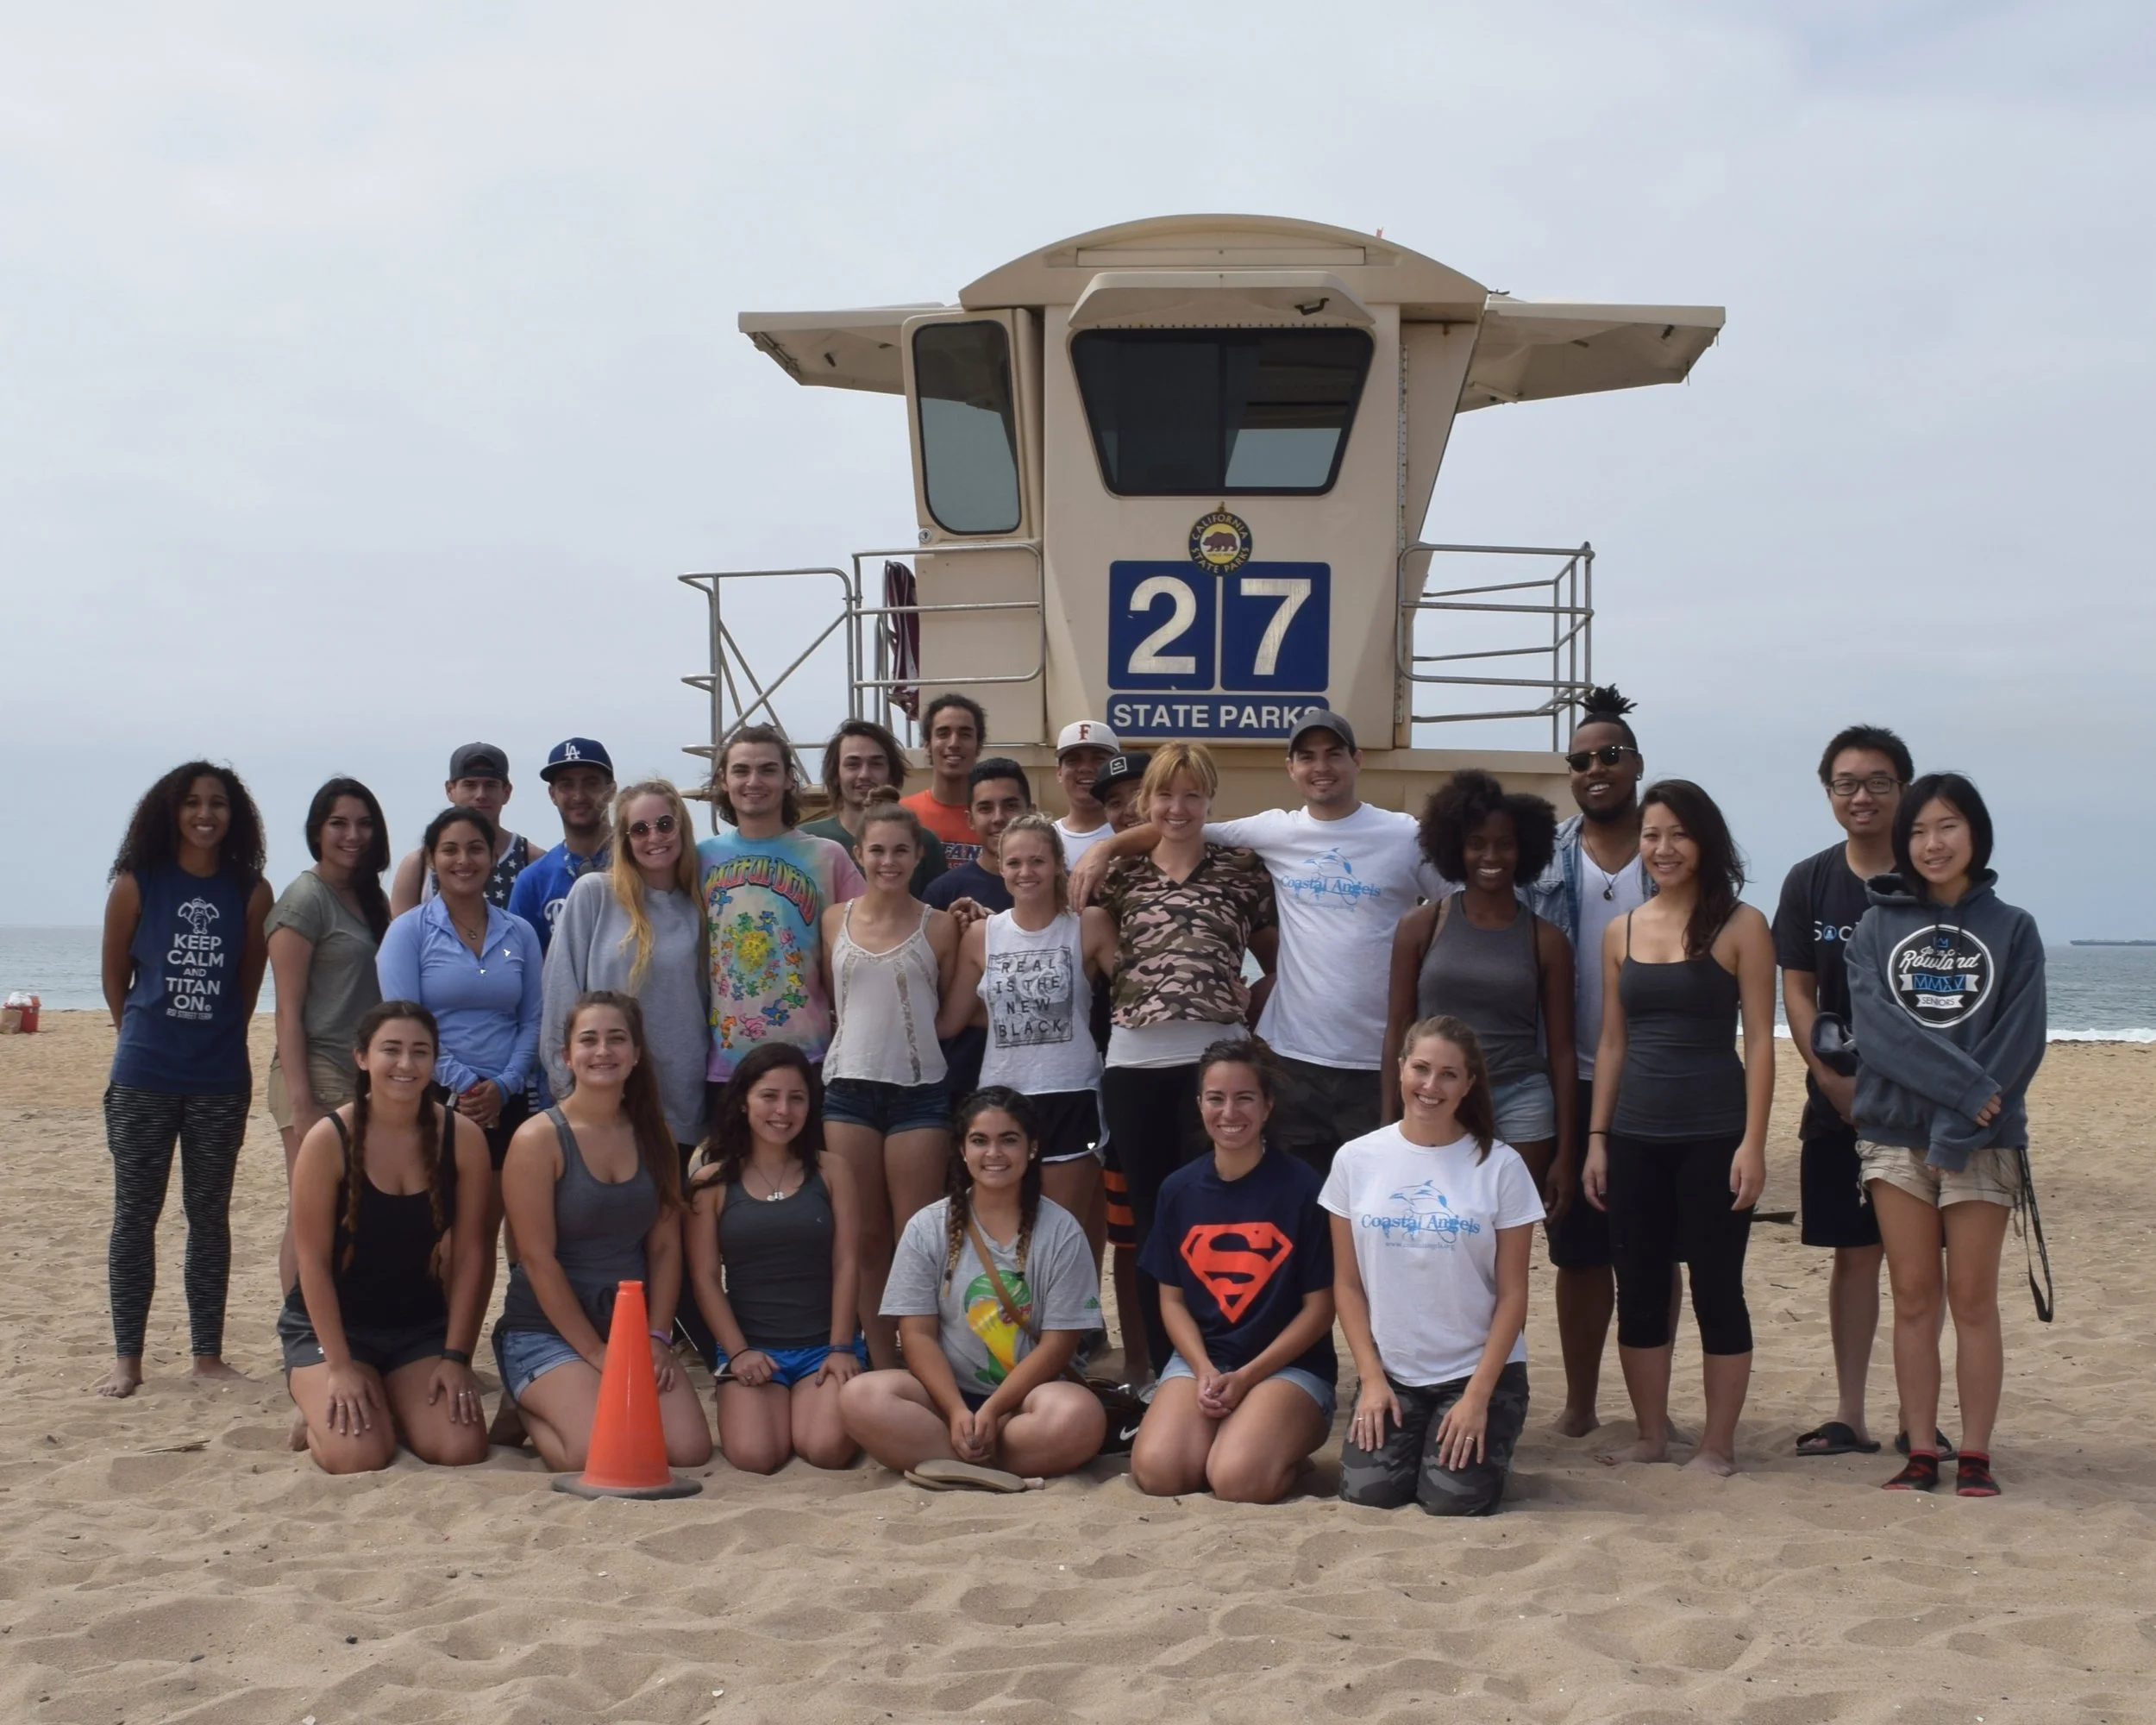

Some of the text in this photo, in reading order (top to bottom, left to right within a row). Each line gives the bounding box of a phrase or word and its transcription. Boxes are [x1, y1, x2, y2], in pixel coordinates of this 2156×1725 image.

[1192, 514, 1249, 541] CALIFORNIA
[1192, 548, 1250, 574] STATE PARKS
[1113, 704, 1209, 728] STATE
[1079, 724, 1092, 741] F
[564, 742, 580, 760] LA
[1280, 875, 1382, 898] Coastal Angels
[173, 933, 222, 951] KEEP
[166, 950, 224, 968] CALM
[1001, 959, 1056, 974] REAL
[1898, 950, 1982, 974] Rowland
[183, 968, 207, 977] AND
[165, 976, 221, 995] TITAN
[995, 975, 1060, 994] IS THE
[1914, 975, 1965, 992] MMXV
[1006, 998, 1050, 1015] NEW
[1921, 996, 1956, 1007] SENIORS
[998, 1019, 1062, 1038] BLACK
[1361, 1214, 1481, 1237] Coastal Angels
